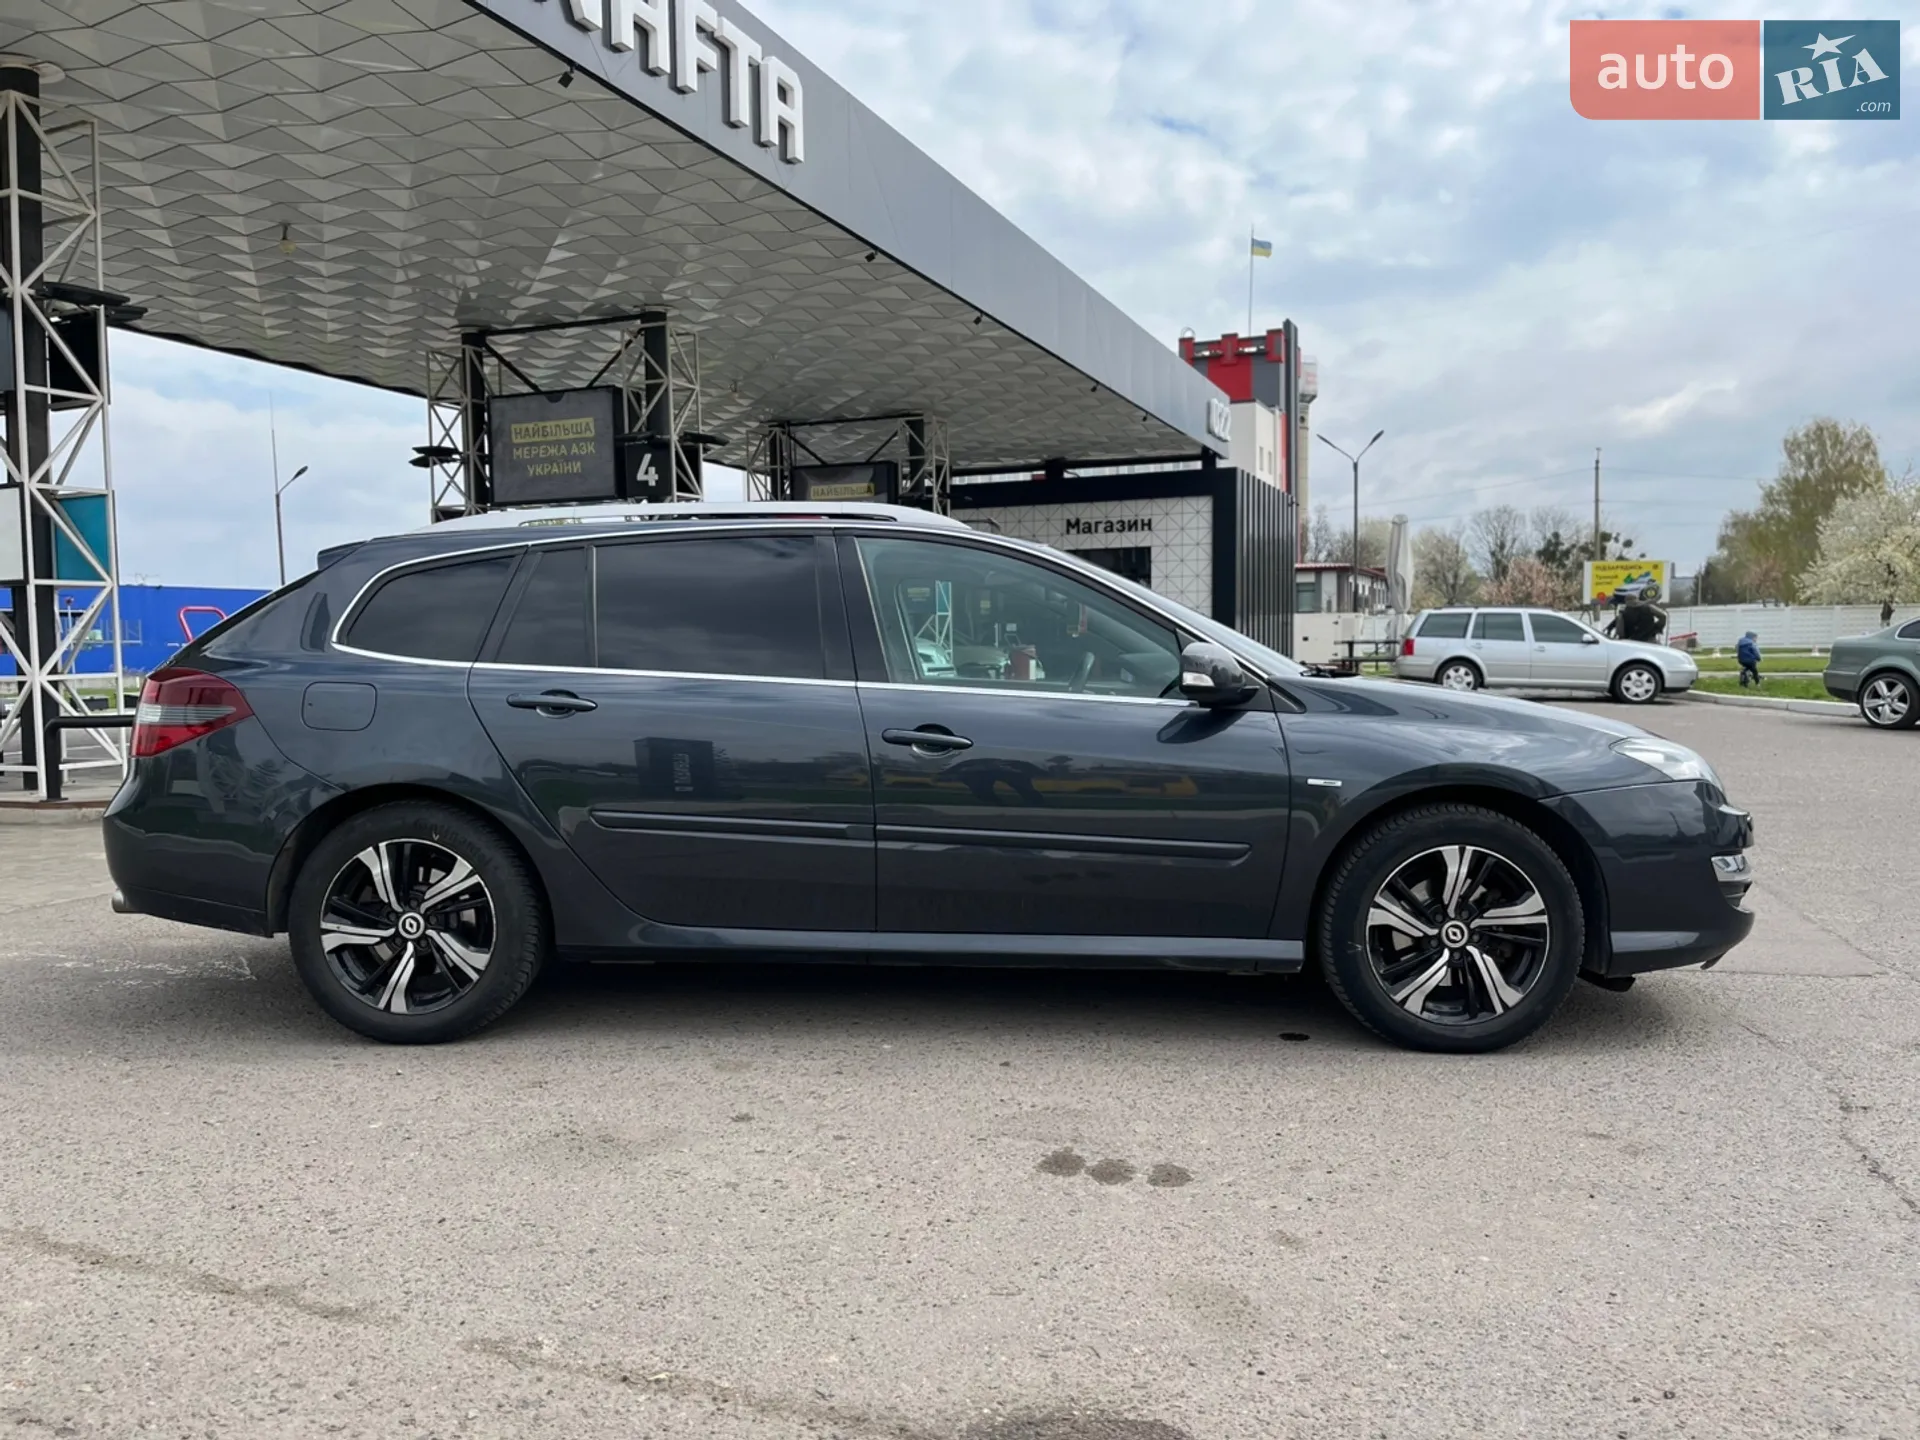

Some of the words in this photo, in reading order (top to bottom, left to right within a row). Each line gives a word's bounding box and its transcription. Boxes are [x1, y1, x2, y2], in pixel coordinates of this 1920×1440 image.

[513, 421, 593, 440] НАЙБІЛЬША
[513, 445, 567, 460] МЕРЕЖА
[571, 441, 596, 455] АЗК
[527, 459, 582, 477] УКРАЇНИ
[636, 453, 659, 487] 4
[1065, 517, 1152, 535] Магазин
